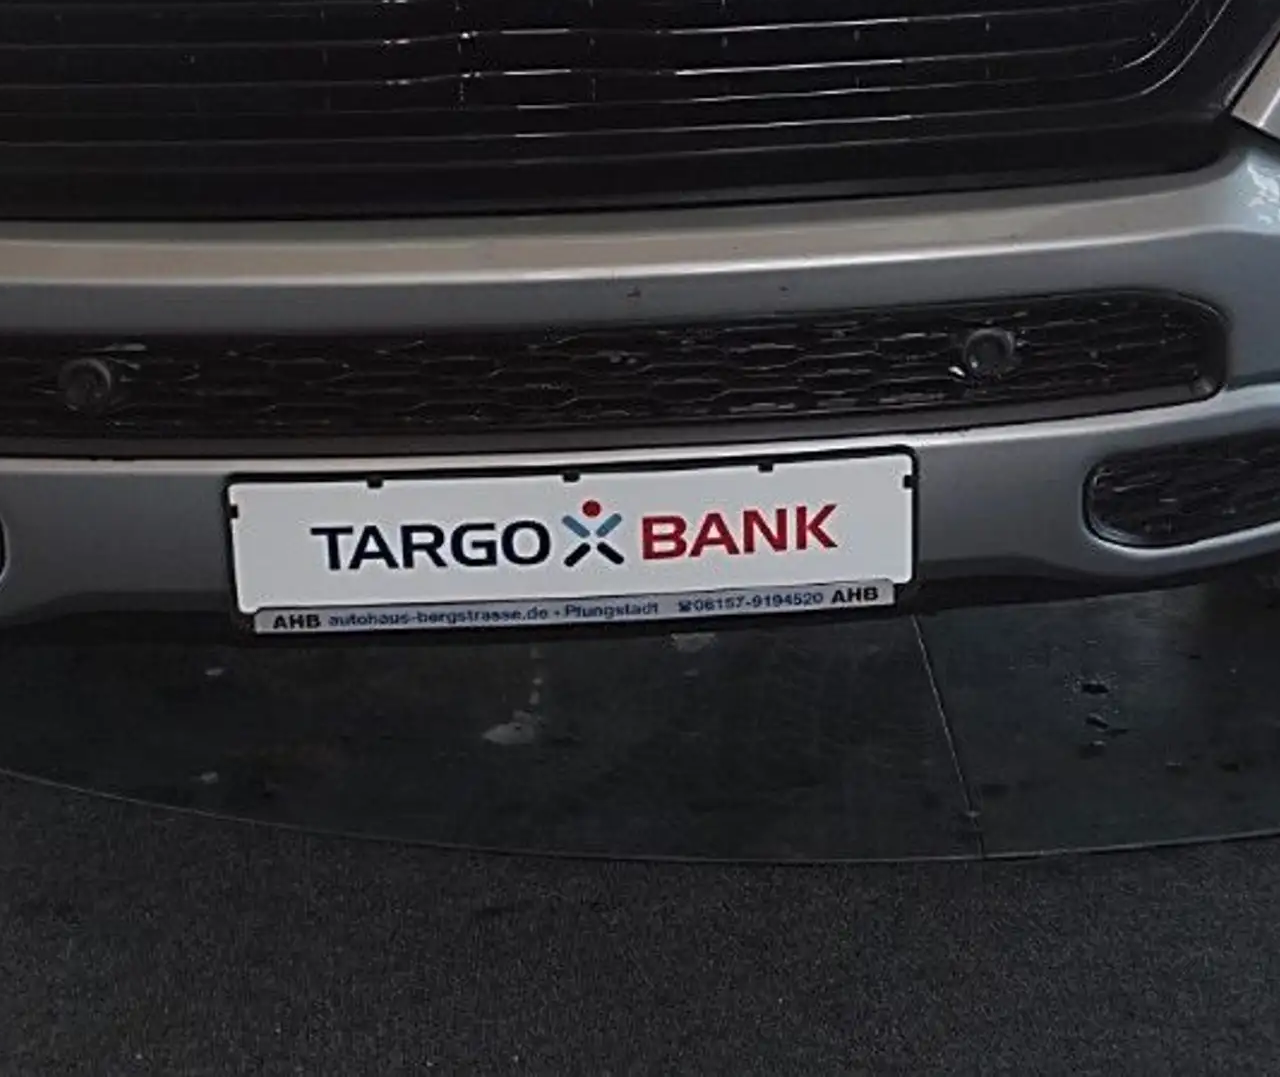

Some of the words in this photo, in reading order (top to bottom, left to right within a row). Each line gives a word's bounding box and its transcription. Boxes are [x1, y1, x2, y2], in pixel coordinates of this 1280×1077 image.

[310, 520, 551, 570] TARGO
[642, 504, 838, 560] BANK
[272, 612, 322, 630] AHB
[831, 586, 879, 604] AHB
